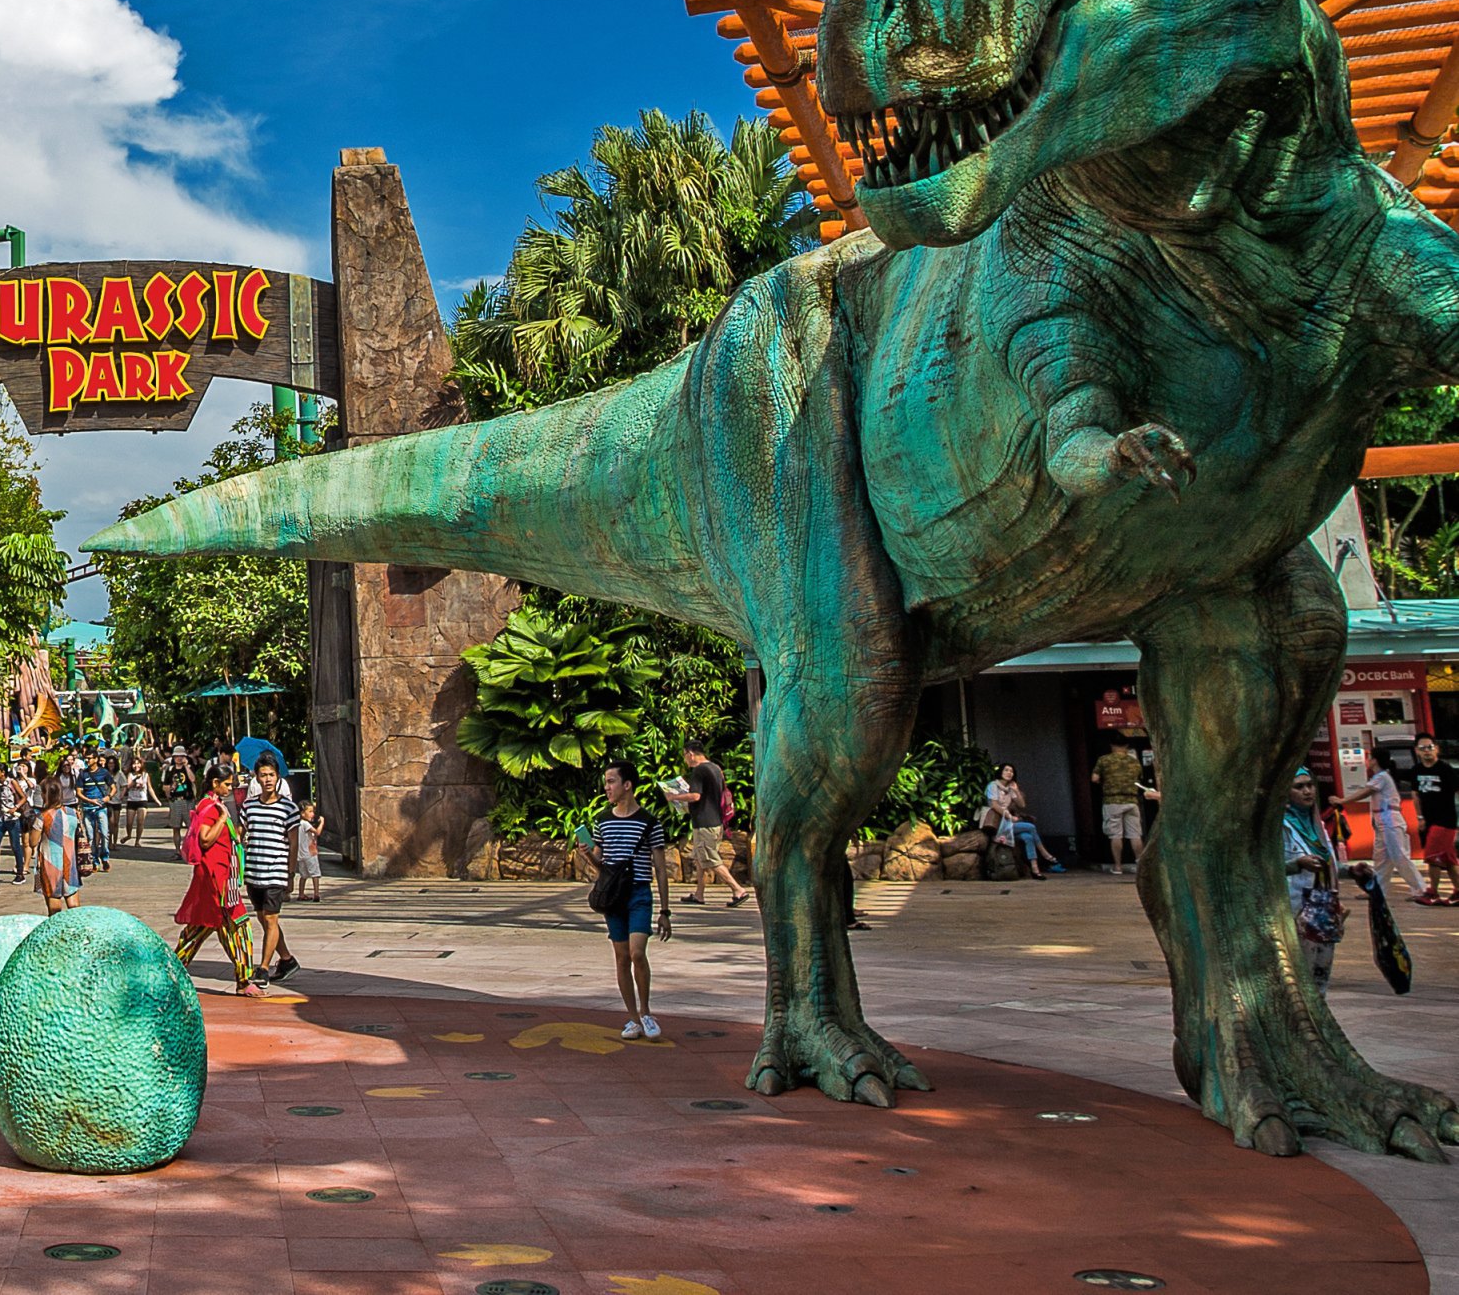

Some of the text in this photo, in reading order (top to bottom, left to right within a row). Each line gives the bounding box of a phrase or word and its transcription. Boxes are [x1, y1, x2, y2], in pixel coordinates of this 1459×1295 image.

[48, 346, 194, 412] PARK
[1357, 670, 1415, 681] OCBC Bank
[1102, 707, 1122, 715] Atm
